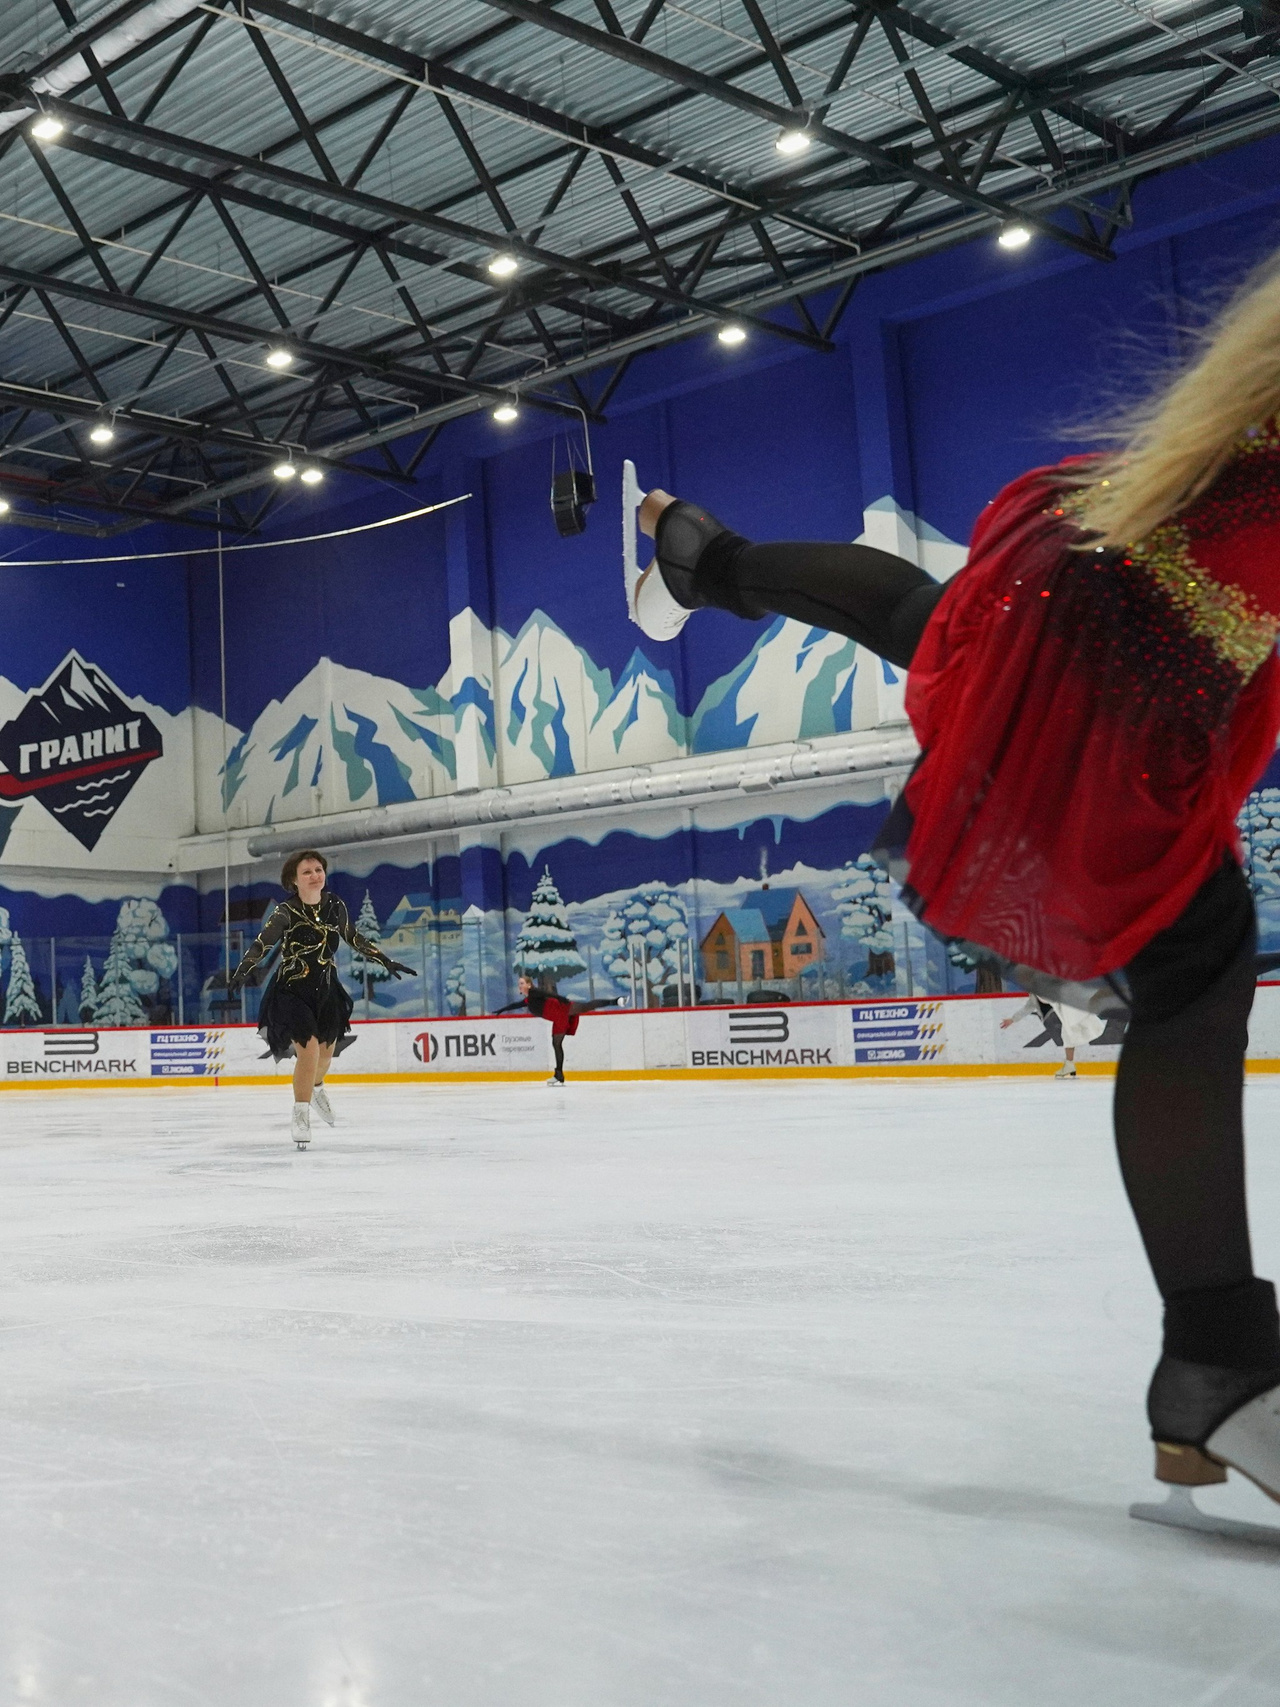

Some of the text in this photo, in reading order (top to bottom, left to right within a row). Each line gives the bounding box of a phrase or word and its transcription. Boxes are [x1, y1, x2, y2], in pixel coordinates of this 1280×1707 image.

[19, 718, 142, 775] ГРАНИТ
[874, 1007, 909, 1019] ТЕХНО
[169, 1034, 199, 1043] ТЕХНО
[445, 1033, 497, 1057] ПВК
[691, 1048, 833, 1066] BENCHMARK
[6, 1059, 137, 1074] BENCHMARK
